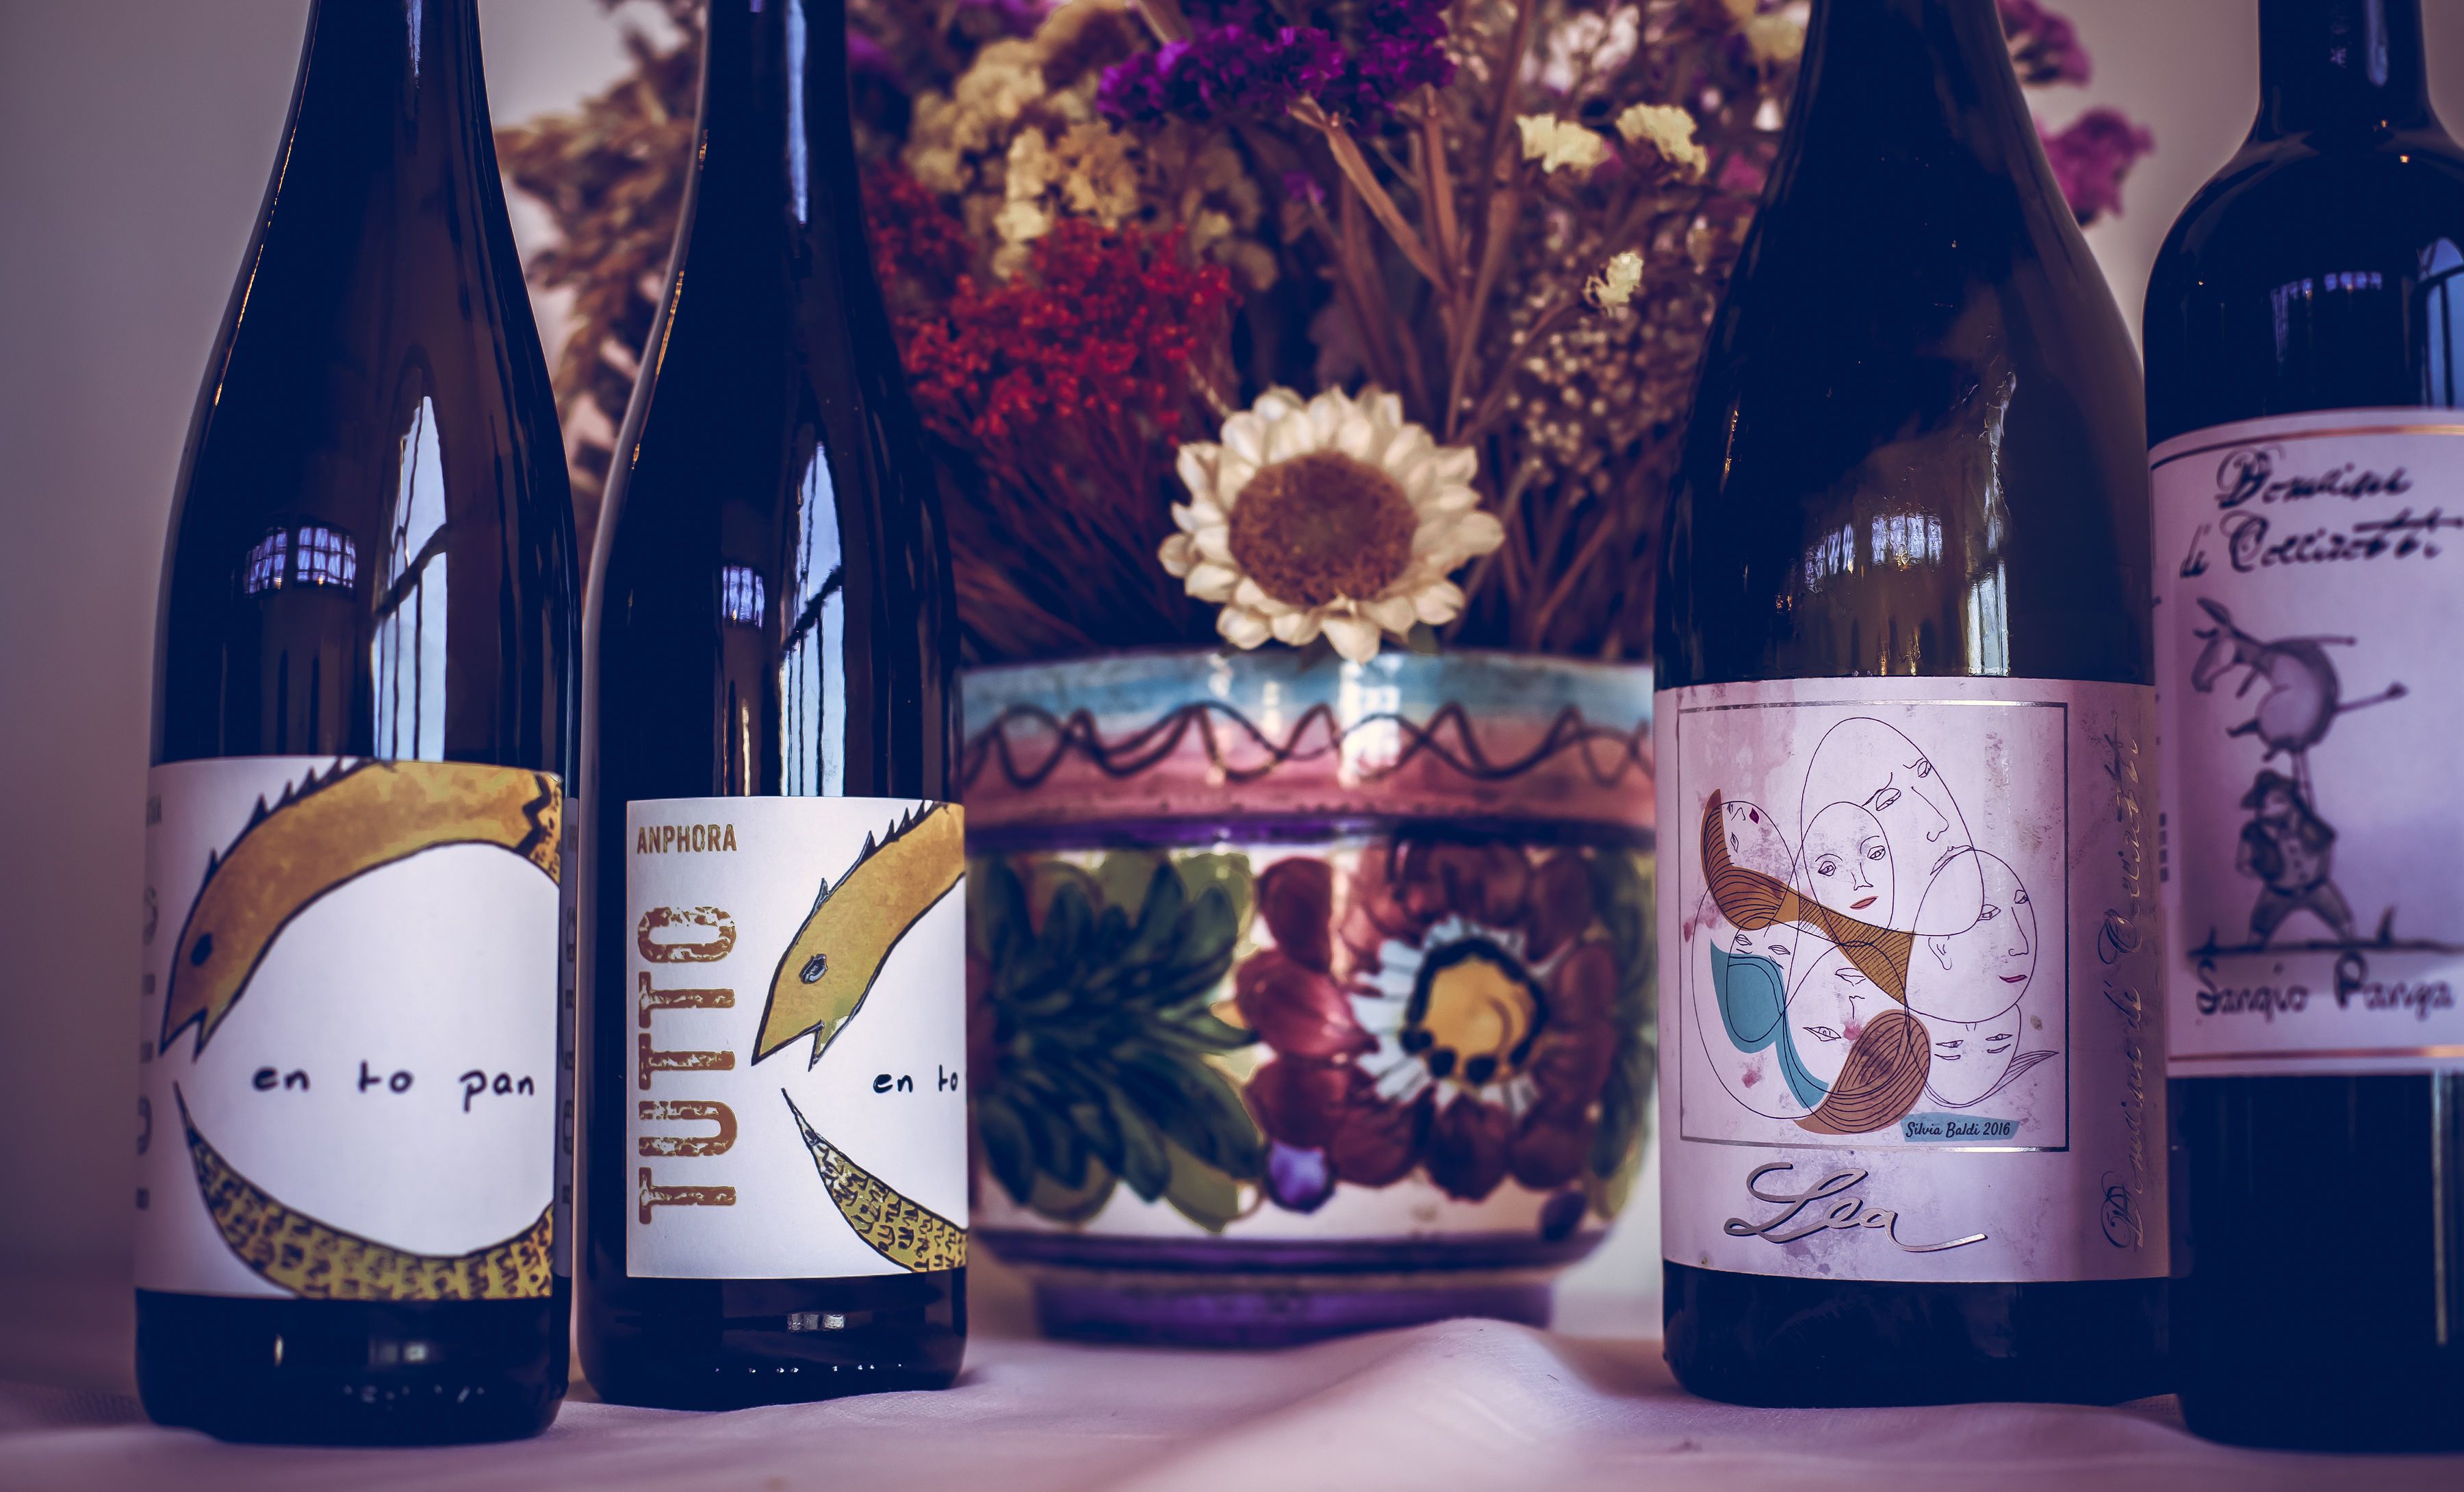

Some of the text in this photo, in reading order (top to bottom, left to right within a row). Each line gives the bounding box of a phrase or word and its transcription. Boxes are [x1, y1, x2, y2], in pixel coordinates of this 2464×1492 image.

[637, 823, 737, 854] ANPHORA
[637, 906, 737, 1224] TUTTO
[873, 1064, 958, 1093] en to
[252, 1060, 535, 1112] en to pan
[1905, 1121, 2011, 1138] Silvia Baldi 2016
[1723, 1161, 1988, 1253] Lea
